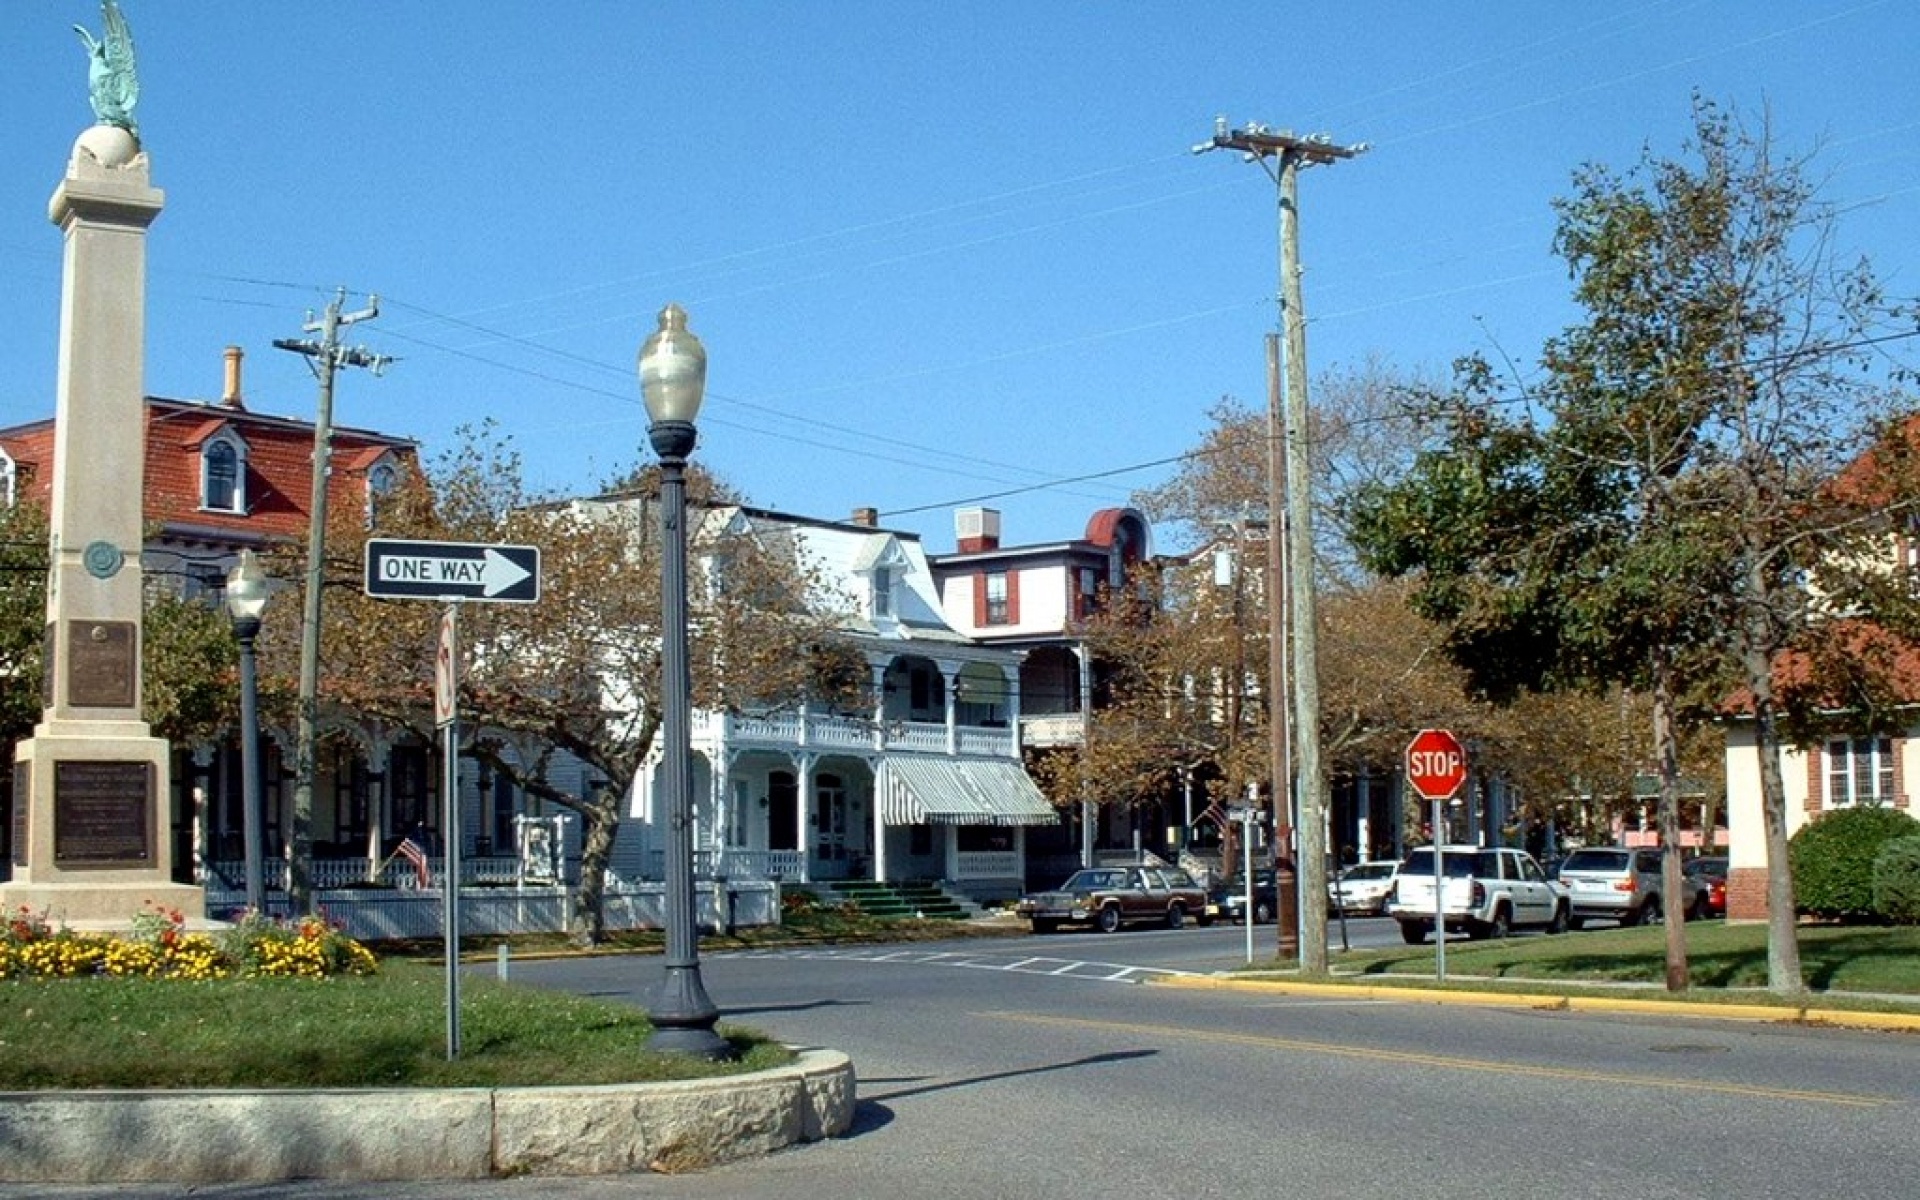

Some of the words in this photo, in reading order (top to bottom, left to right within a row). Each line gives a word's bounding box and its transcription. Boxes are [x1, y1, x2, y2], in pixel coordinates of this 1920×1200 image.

[386, 558, 432, 580] ONE
[440, 560, 487, 582] WAY
[1411, 751, 1460, 777] STOP
